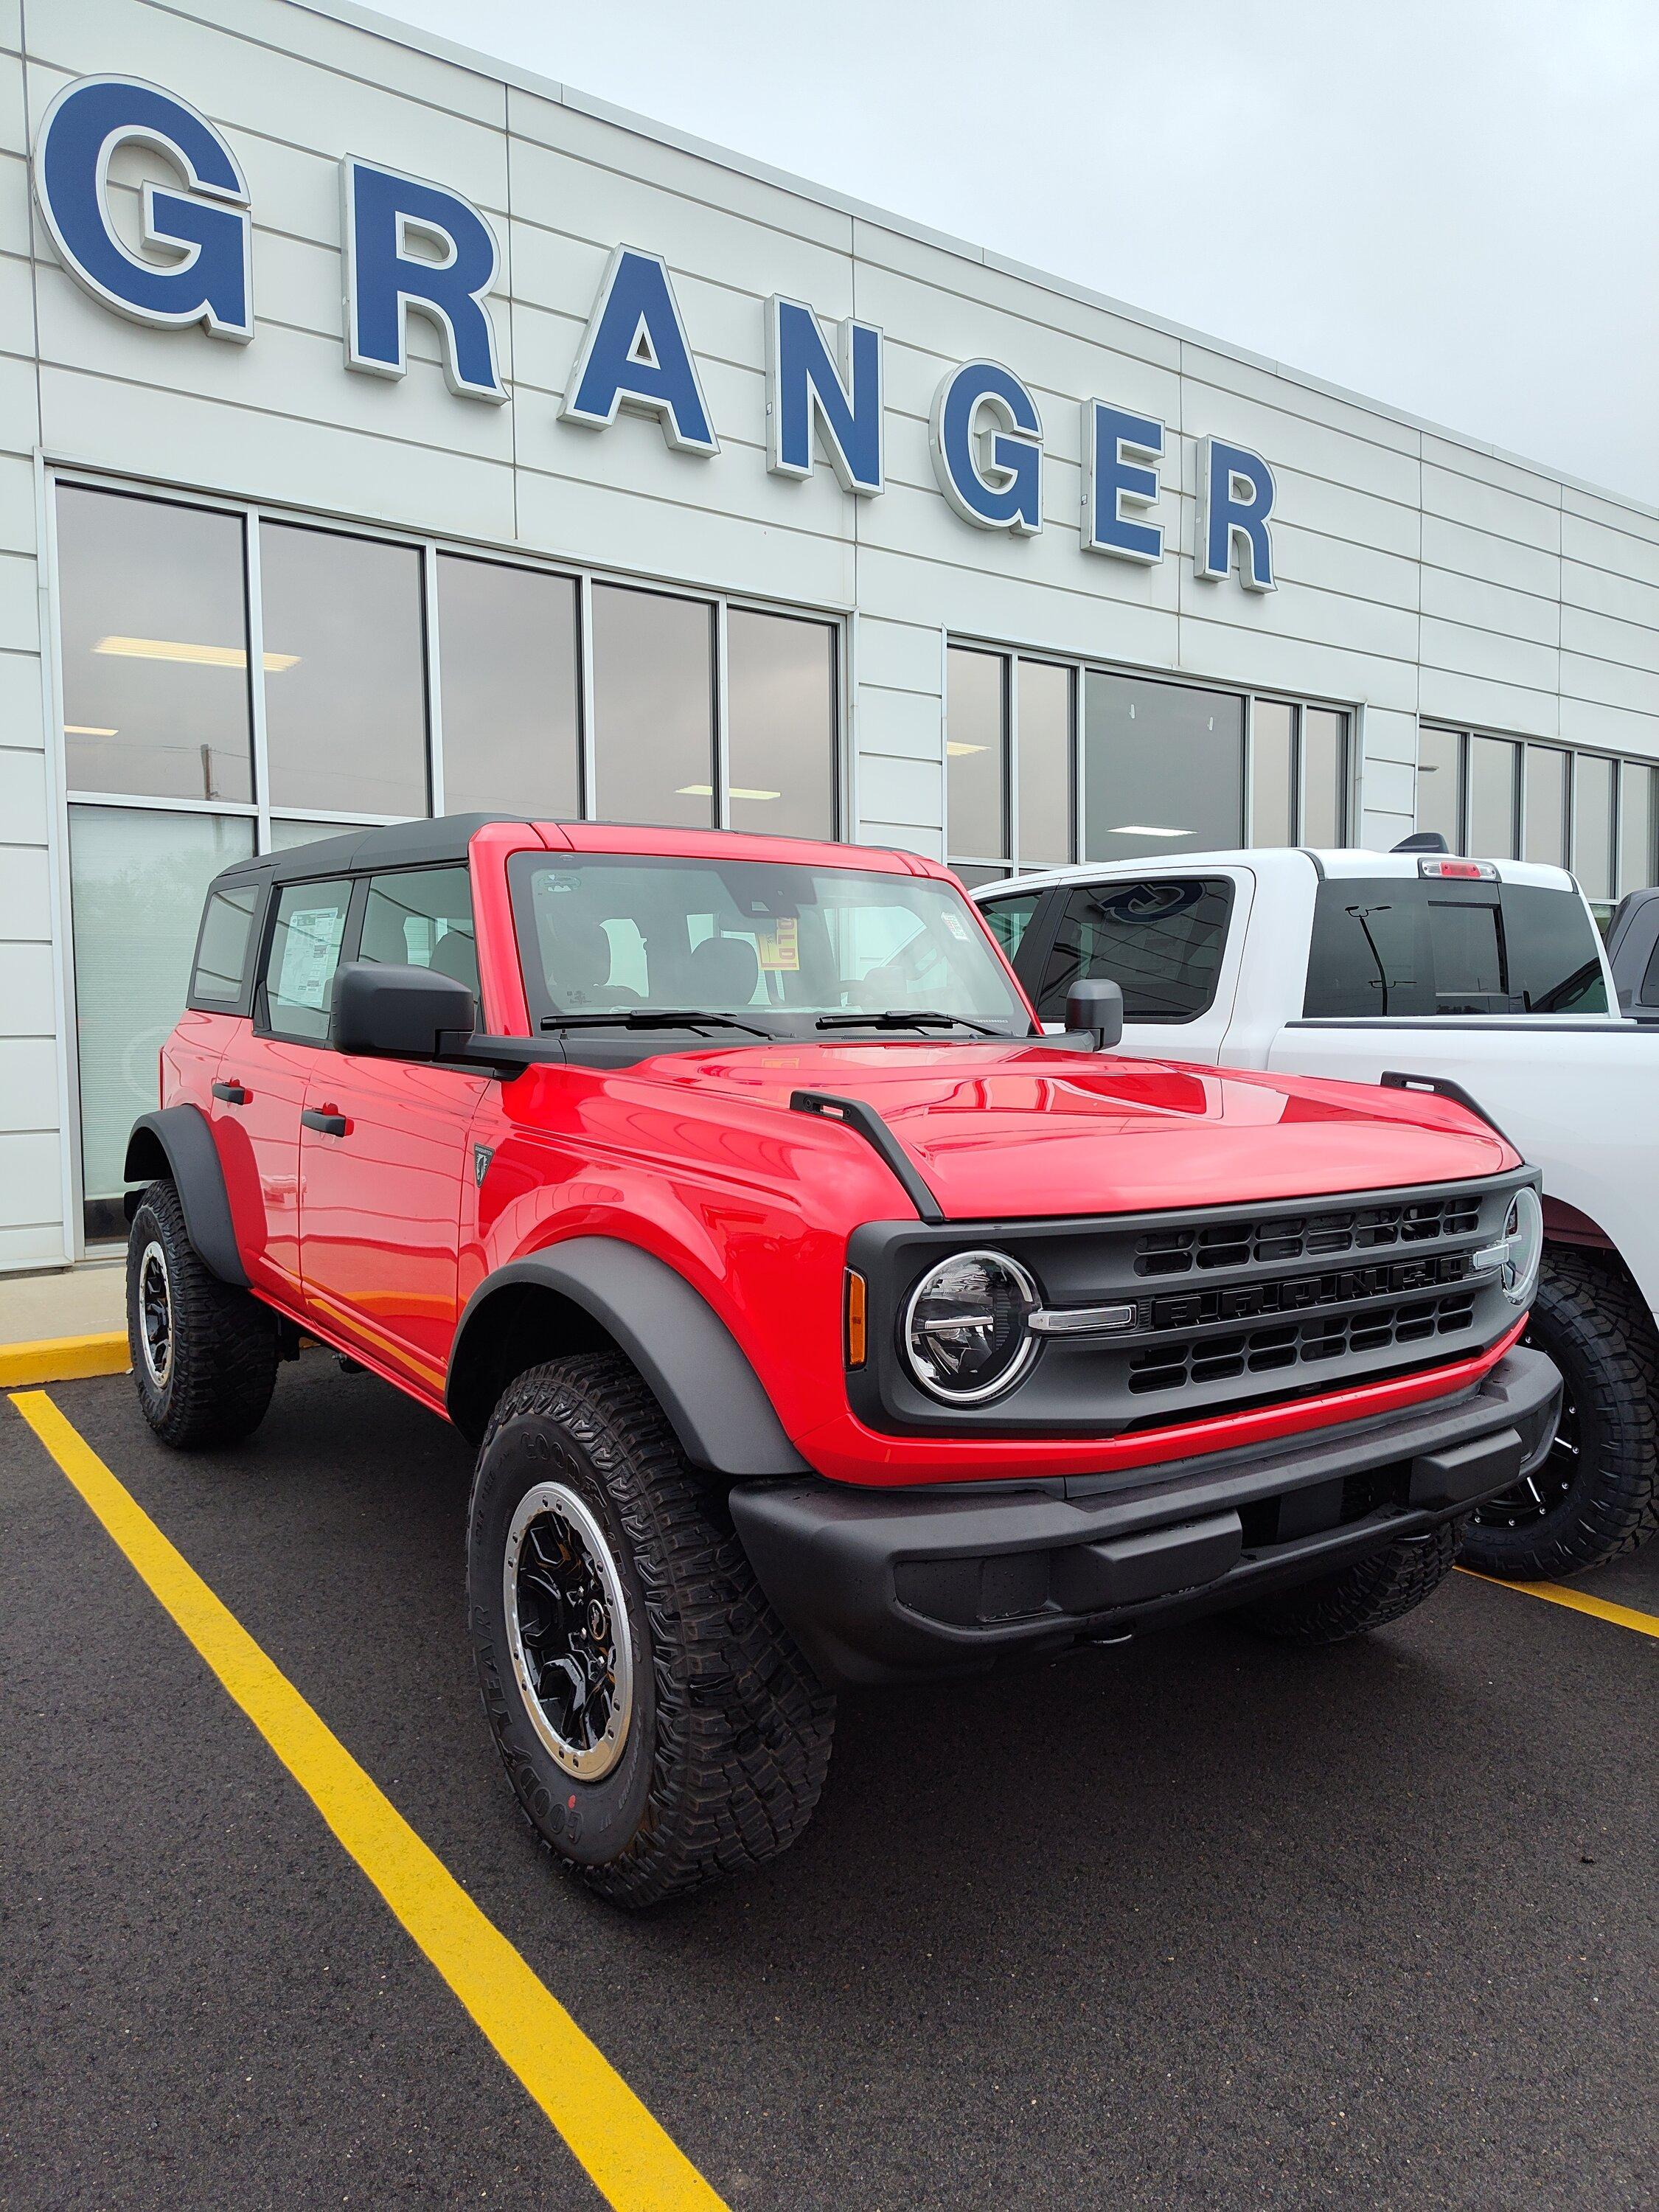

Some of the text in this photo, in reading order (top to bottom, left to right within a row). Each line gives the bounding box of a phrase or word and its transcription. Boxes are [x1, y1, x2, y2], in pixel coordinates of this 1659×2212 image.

[34, 72, 1276, 594] GRANGER
[777, 917, 796, 959] OLD
[1154, 1254, 1470, 1321] BRONCO
